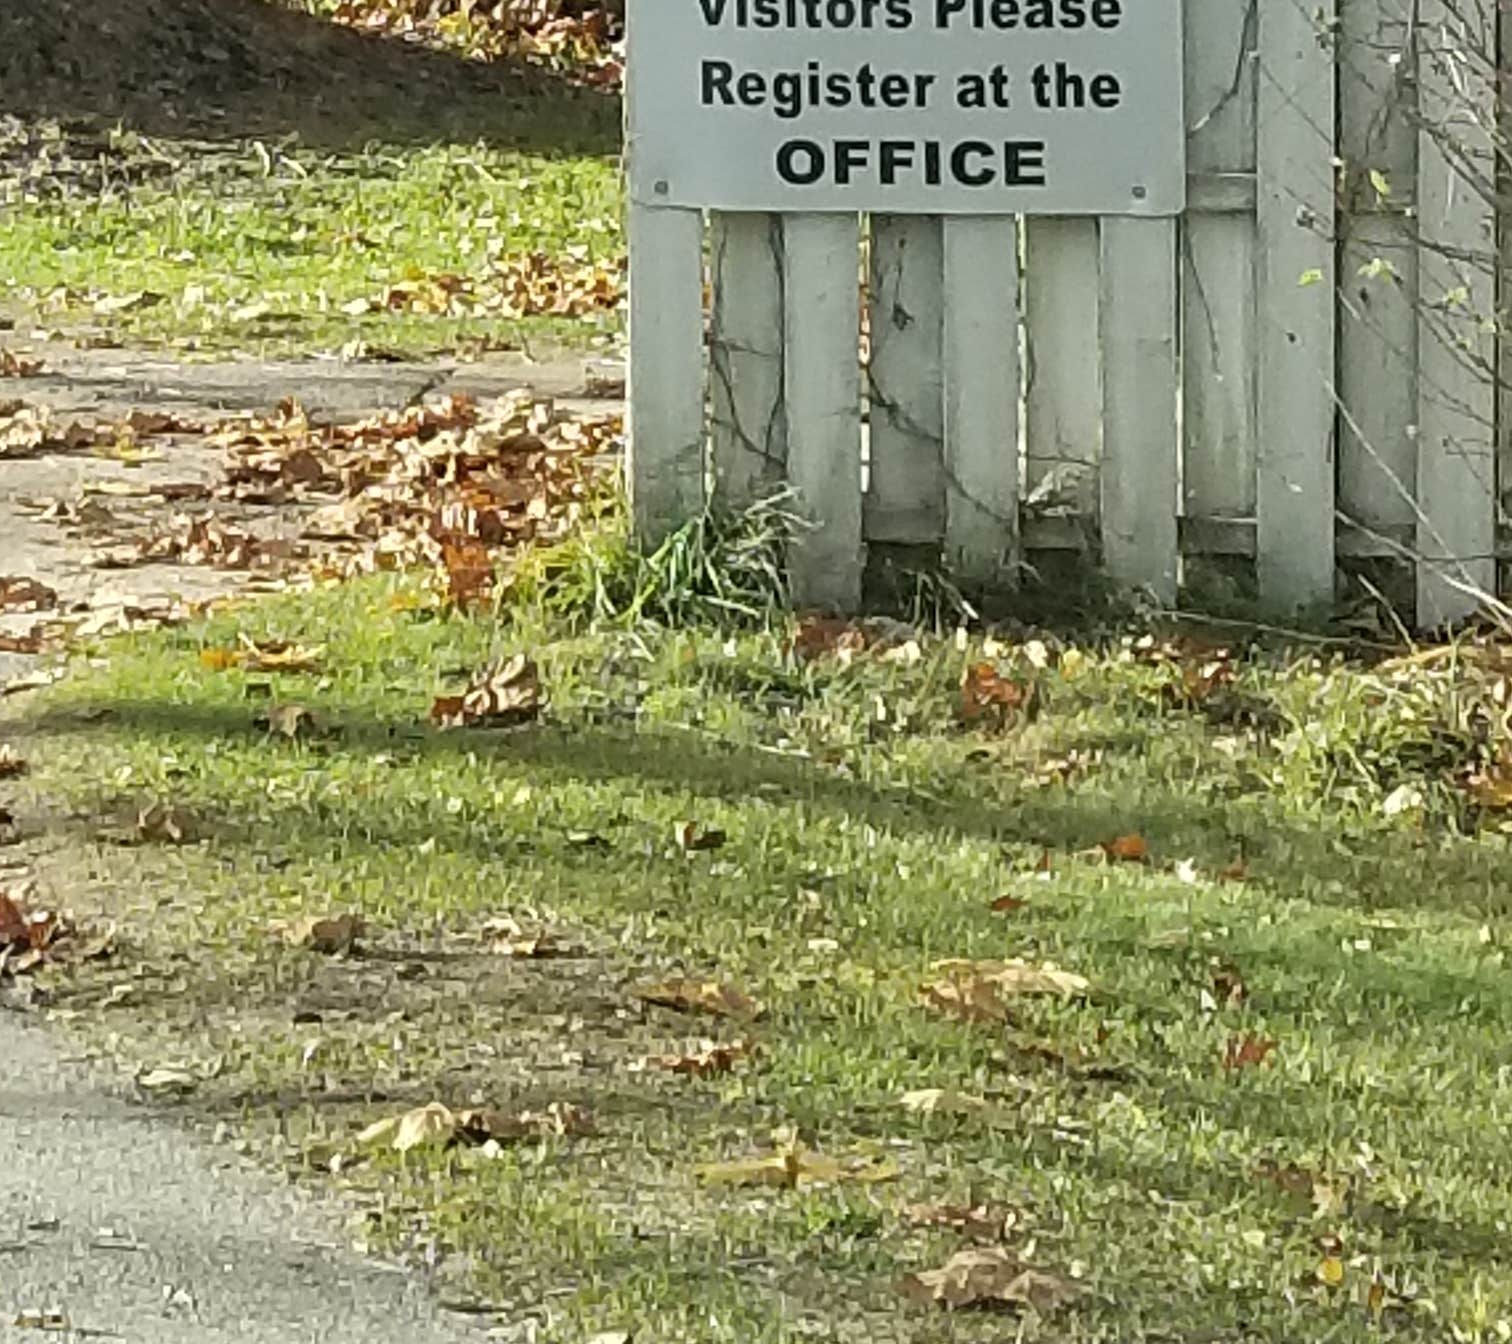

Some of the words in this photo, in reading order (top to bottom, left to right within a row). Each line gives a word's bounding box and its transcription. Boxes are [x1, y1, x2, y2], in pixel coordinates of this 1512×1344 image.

[701, 60, 936, 119] Register
[956, 65, 1009, 108] at
[1030, 62, 1121, 108] the
[775, 139, 1046, 187] OFFICE
